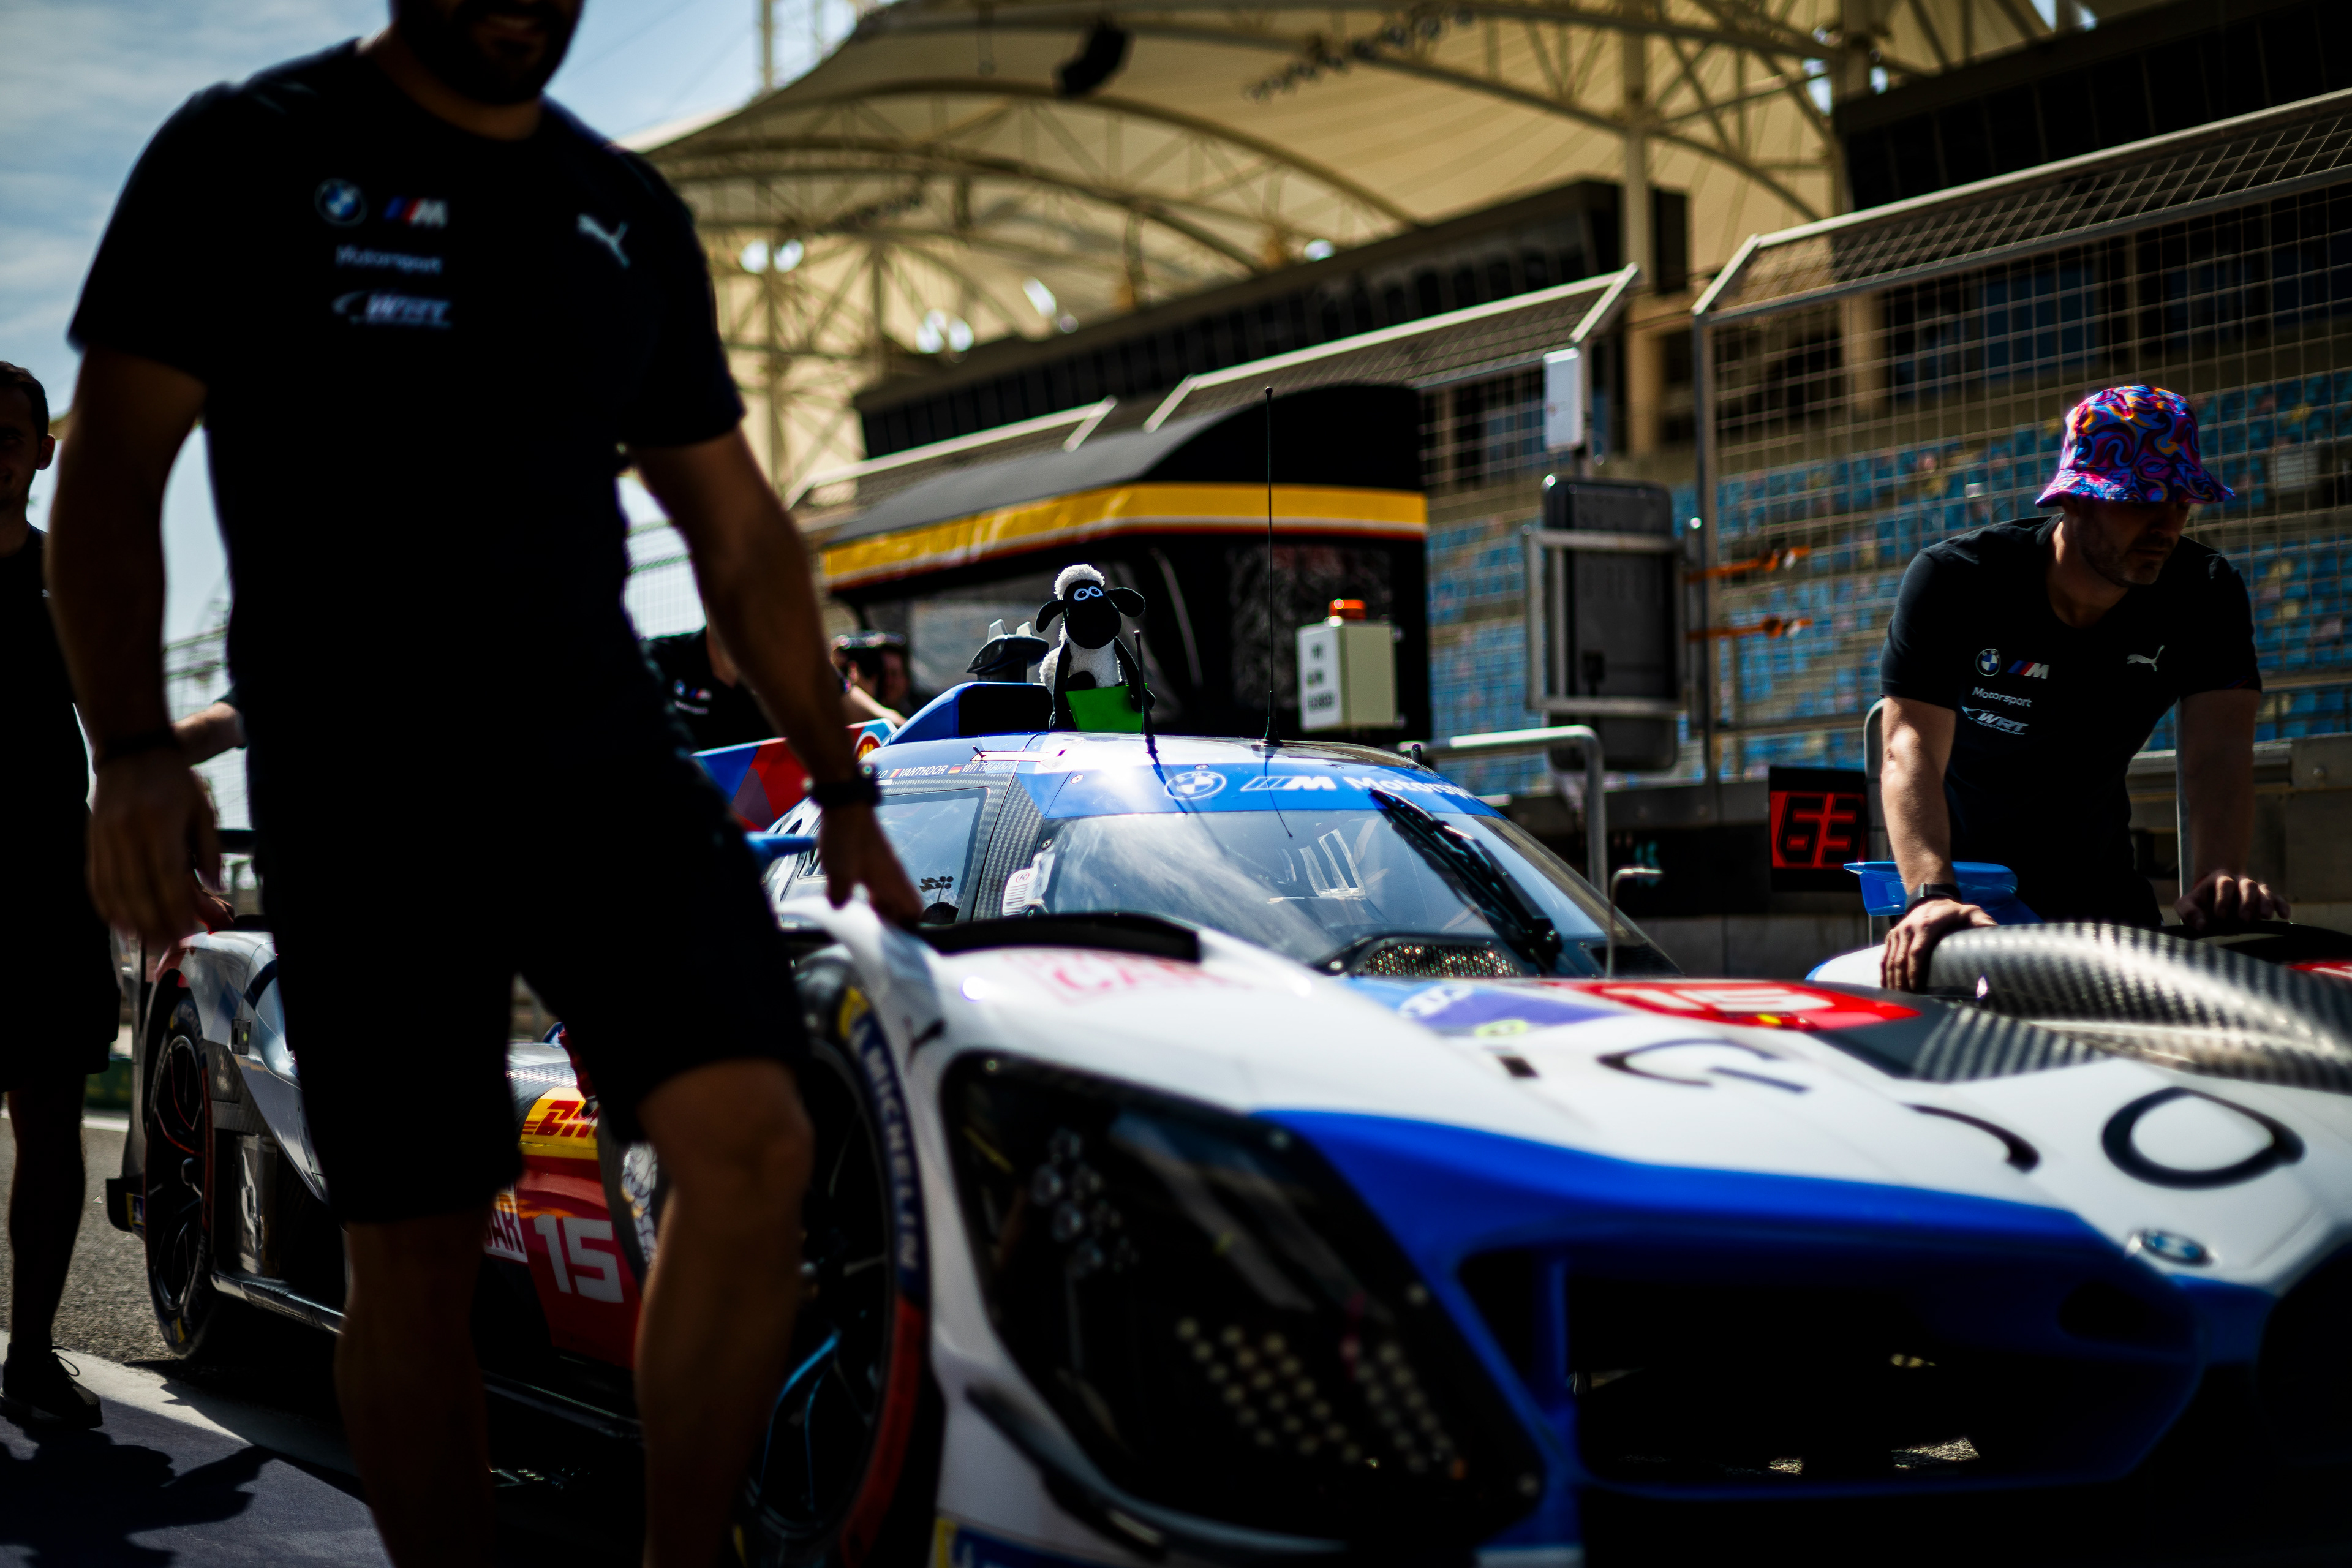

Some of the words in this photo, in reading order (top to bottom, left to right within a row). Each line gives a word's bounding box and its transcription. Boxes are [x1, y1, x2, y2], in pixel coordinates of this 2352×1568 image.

[1972, 687, 2032, 707] Motorsport
[1977, 712, 2029, 732] WRT
[899, 764, 949, 777] VANTHOOR
[1600, 987, 1836, 1012] 15
[533, 1099, 599, 1139] DH
[533, 1213, 624, 1303] 15
